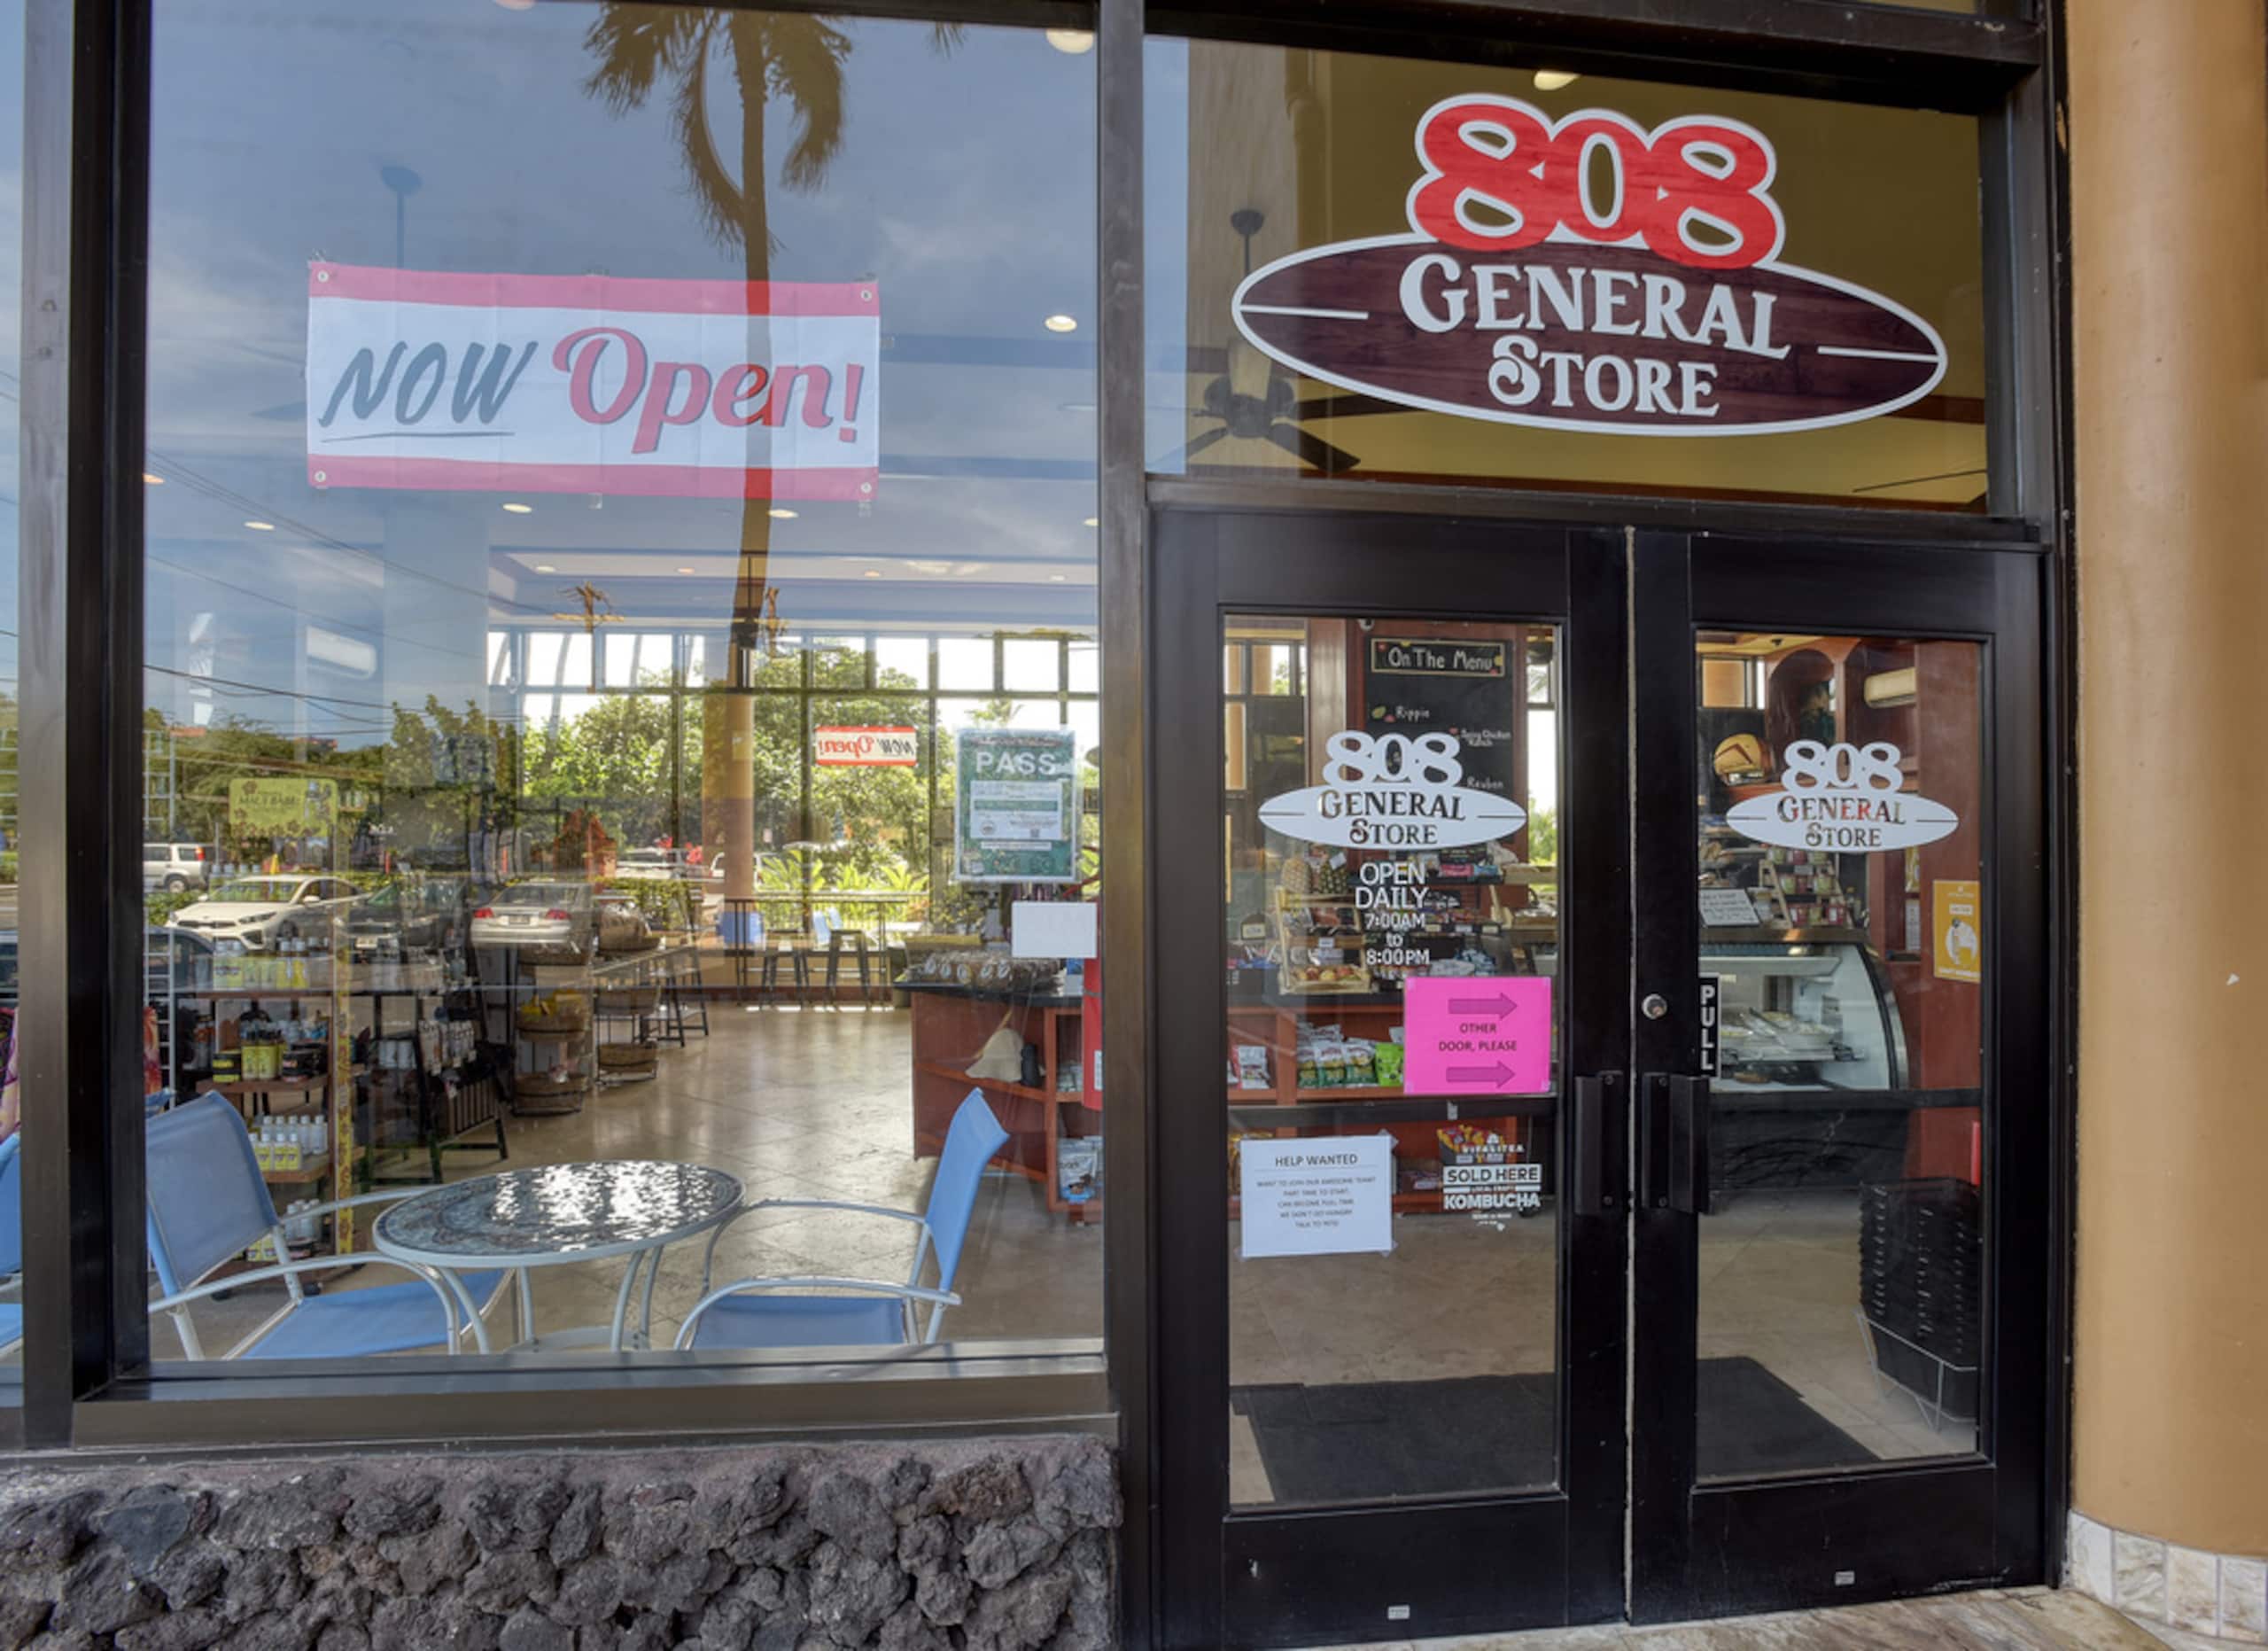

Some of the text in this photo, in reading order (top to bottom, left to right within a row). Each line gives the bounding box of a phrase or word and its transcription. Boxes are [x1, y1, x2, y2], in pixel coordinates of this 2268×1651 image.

[1406, 93, 1785, 269] 808
[1399, 254, 1790, 360] GENERAL
[1488, 334, 1720, 417] STORE
[318, 326, 865, 454] NOW Open!
[1388, 647, 1493, 671] On The Menu
[975, 751, 1057, 775] PASS
[1322, 730, 1464, 788] 808
[1781, 739, 1904, 794] 808
[1318, 790, 1465, 821] GENERAL
[1777, 796, 1907, 825] GENERAL
[1349, 819, 1438, 845] STORE
[1806, 822, 1883, 847] STORE
[1360, 862, 1425, 885] OPEN
[1355, 887, 1429, 909] DAILY
[1364, 913, 1426, 929] 7:00AM
[1366, 949, 1431, 966] 8:00PM
[1459, 1023, 1497, 1034] OTHER
[1700, 985, 1716, 1071] PULL
[1438, 1040, 1518, 1053] DOOR, PLEASE
[1275, 1154, 1358, 1167] HELP WANTED
[1448, 1166, 1539, 1182] SOLD HERE
[1443, 1193, 1541, 1210] KOMBUCHA
